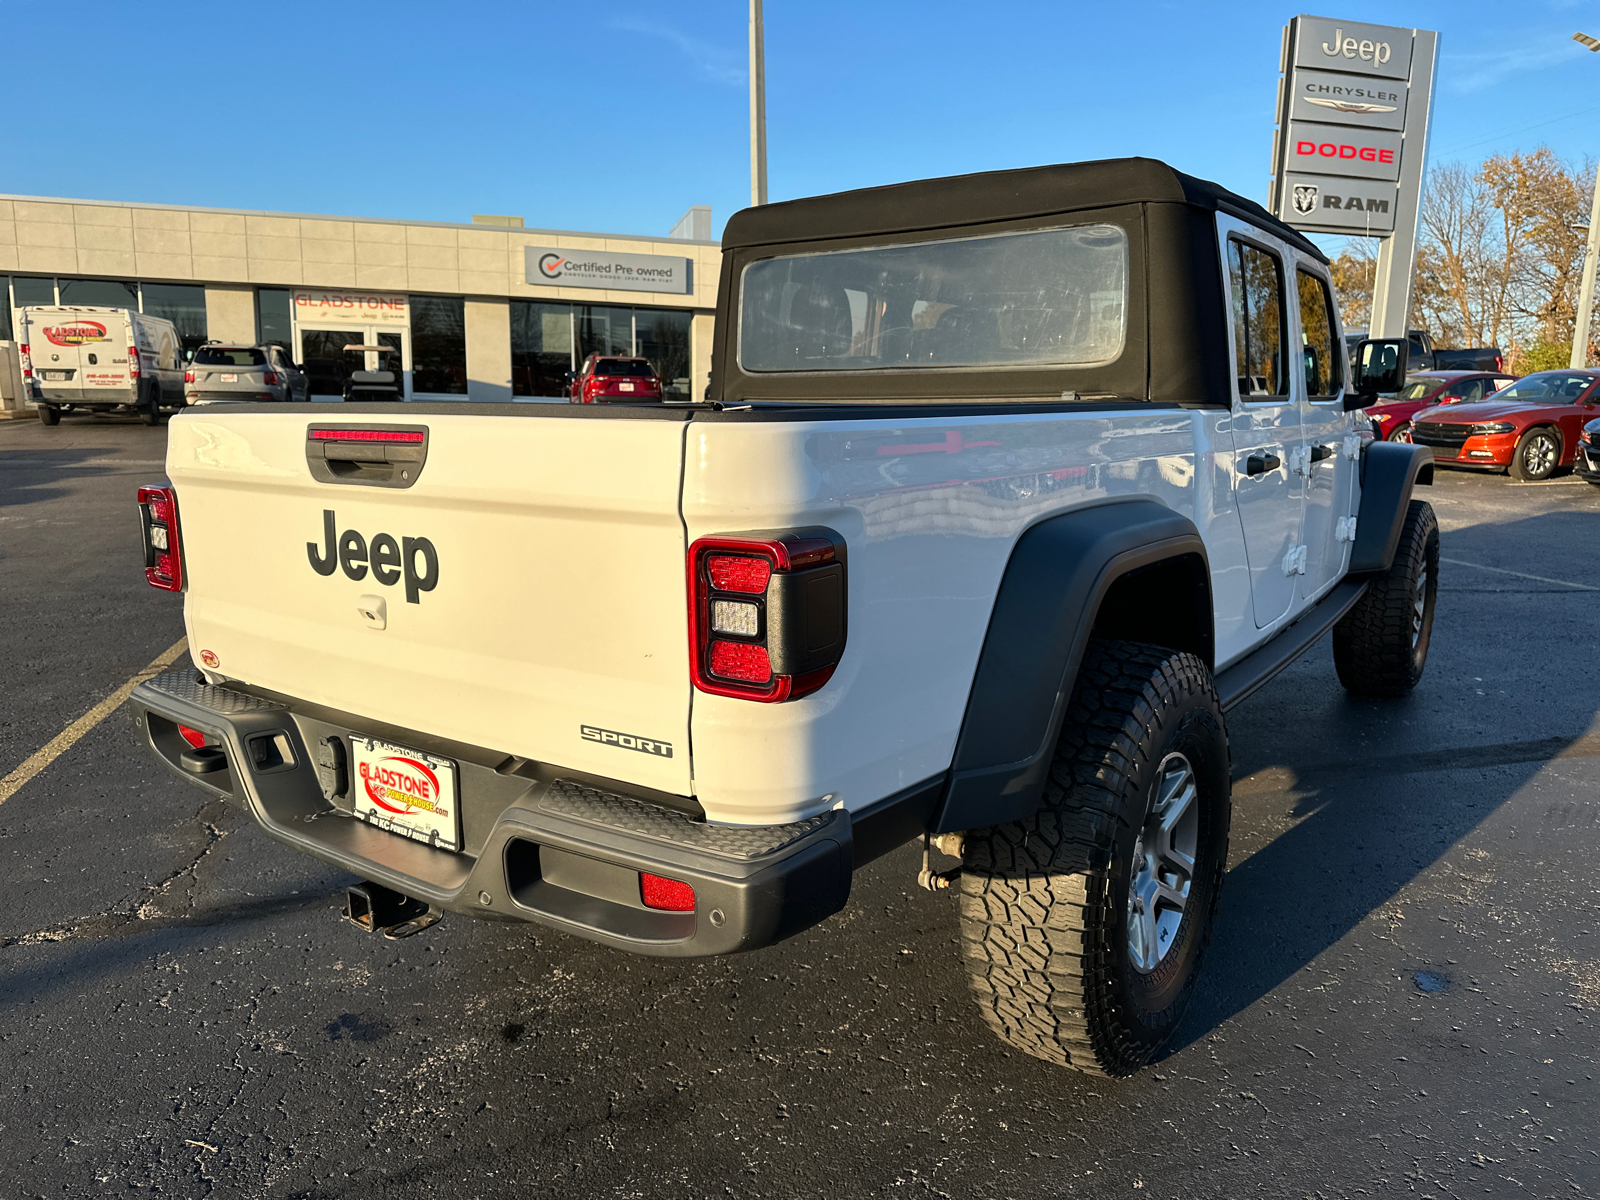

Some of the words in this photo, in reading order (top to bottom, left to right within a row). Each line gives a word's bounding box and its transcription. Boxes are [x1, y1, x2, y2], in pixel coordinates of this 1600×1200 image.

[1322, 28, 1391, 69] Jeep
[1305, 83, 1398, 102] CHRYSLER
[1296, 141, 1394, 164] DODGE
[1322, 194, 1389, 213] RAM
[564, 260, 611, 274] Certified
[615, 264, 673, 278] Pre-owned
[295, 293, 405, 311] GLADSTONE
[361, 312, 377, 320] Jeep
[42, 326, 99, 337] GLADSTONE
[306, 509, 439, 605] Jeep
[373, 740, 424, 760] GLADSTONE
[581, 726, 673, 756] SPORT
[359, 761, 430, 799] GLADSTONE
[372, 784, 386, 798] KC
[386, 787, 409, 803] POWER
[353, 809, 366, 821] Jeep
[369, 815, 379, 826] THE
[379, 818, 390, 831] KC
[390, 823, 408, 836] POWER
[412, 831, 430, 843] HOUSE
